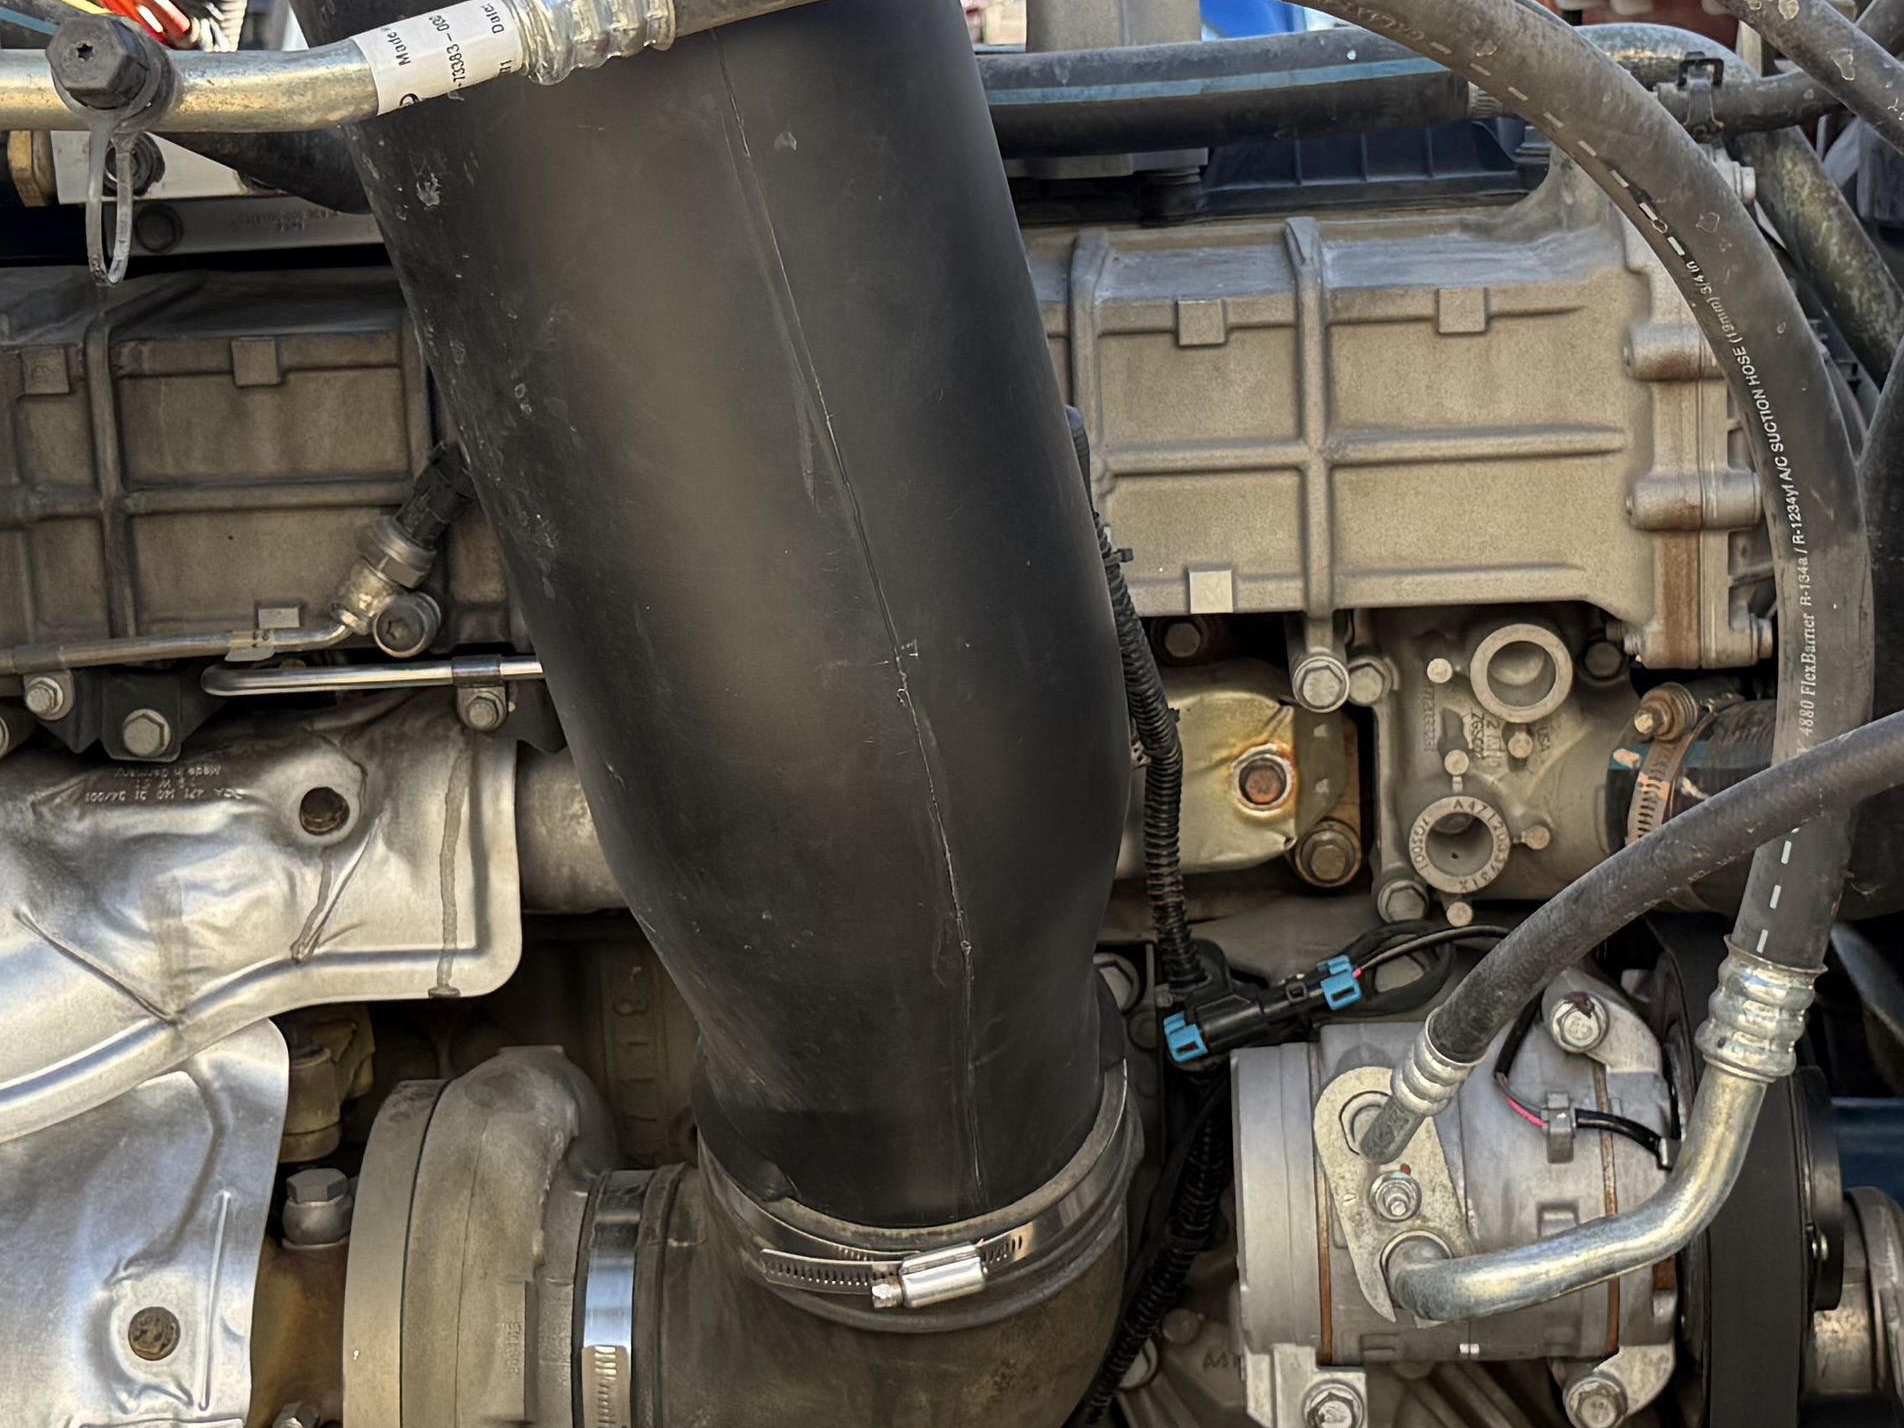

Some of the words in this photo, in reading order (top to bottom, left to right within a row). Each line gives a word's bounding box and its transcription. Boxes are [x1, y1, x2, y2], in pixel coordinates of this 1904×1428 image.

[386, 30, 412, 67] Made
[1694, 274, 1713, 295] 3/4
[1706, 296, 1744, 344] (19mm)
[1732, 345, 1761, 386] HOSE
[1751, 388, 1785, 453] SUCTION
[1774, 455, 1793, 481] A/C
[1781, 482, 1807, 545] R-1234yf
[1797, 556, 1813, 607] R-134a
[1800, 612, 1816, 696] FlexBarrier
[1798, 699, 1816, 737] 4880
